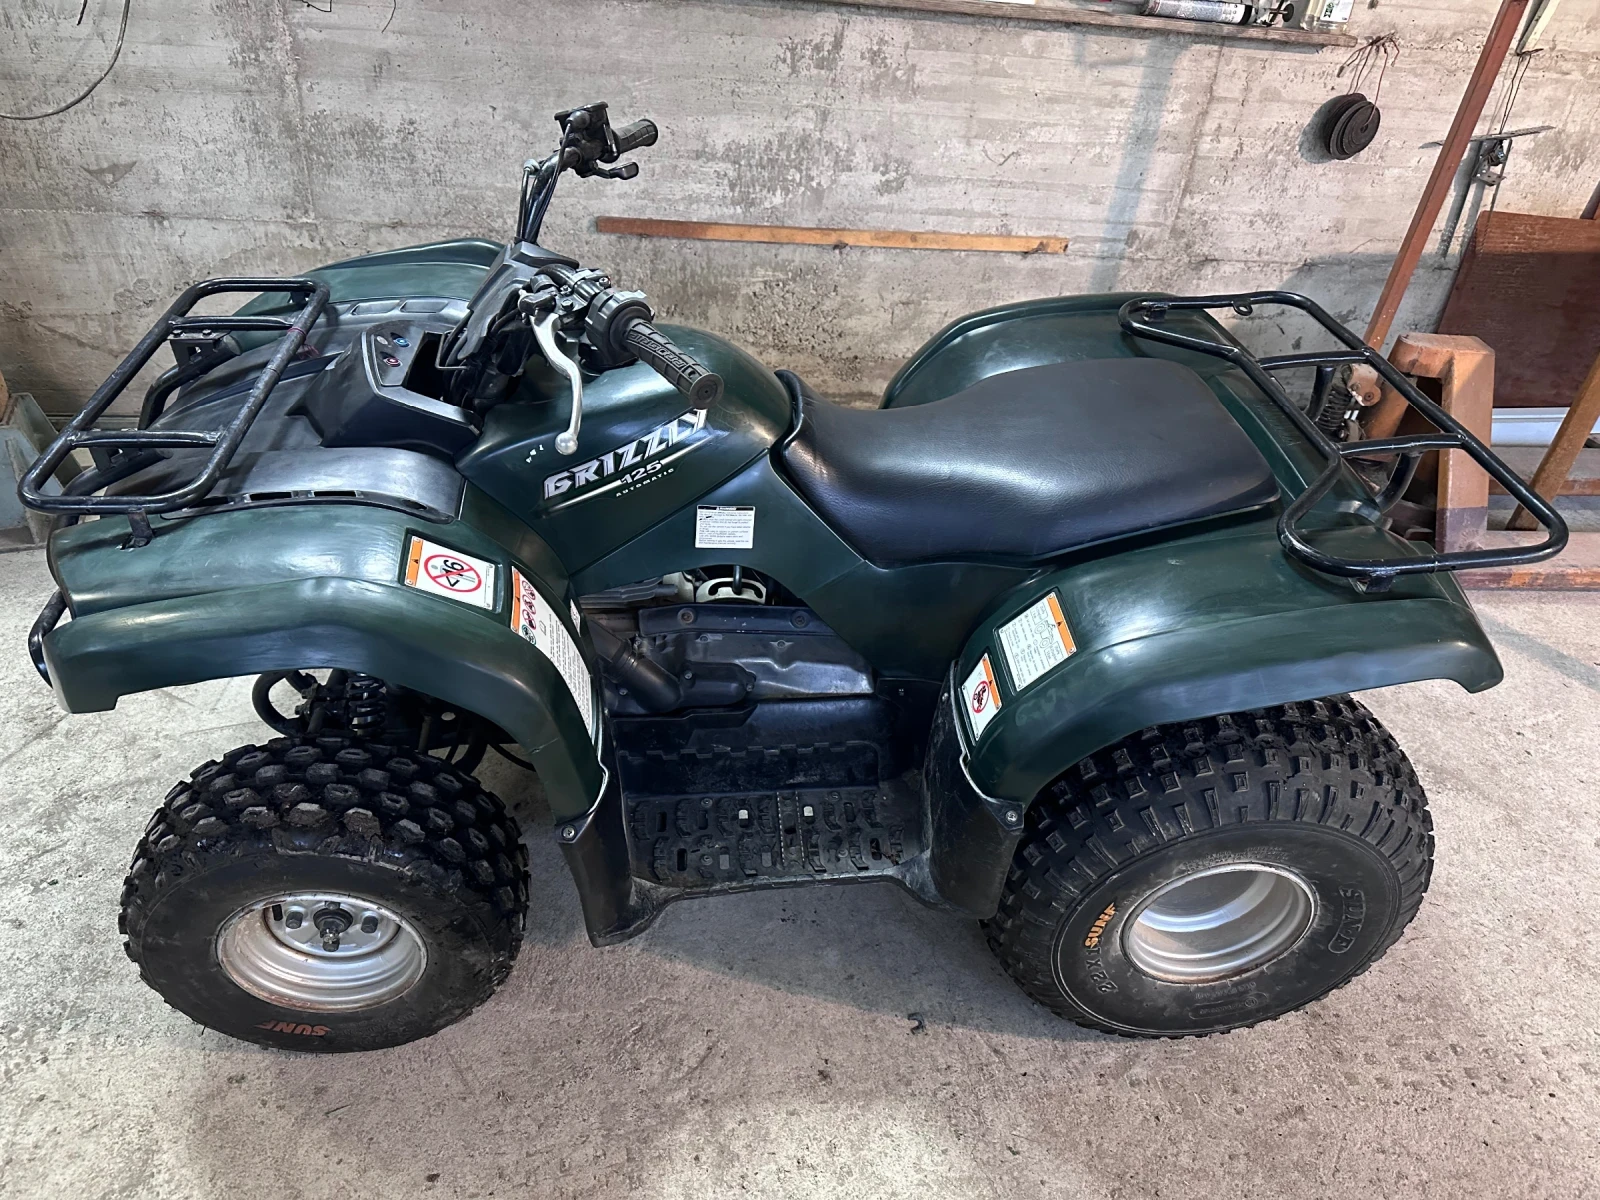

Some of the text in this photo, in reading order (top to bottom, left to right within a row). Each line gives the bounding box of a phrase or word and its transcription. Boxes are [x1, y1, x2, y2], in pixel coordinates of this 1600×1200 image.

[628, 332, 686, 369] PROGRIP
[543, 408, 708, 500] GRIZZLY
[615, 468, 675, 498] AUTOMATIC
[620, 459, 663, 485] 125
[1084, 902, 1117, 948] SUNF
[254, 1019, 332, 1037] SUNF
